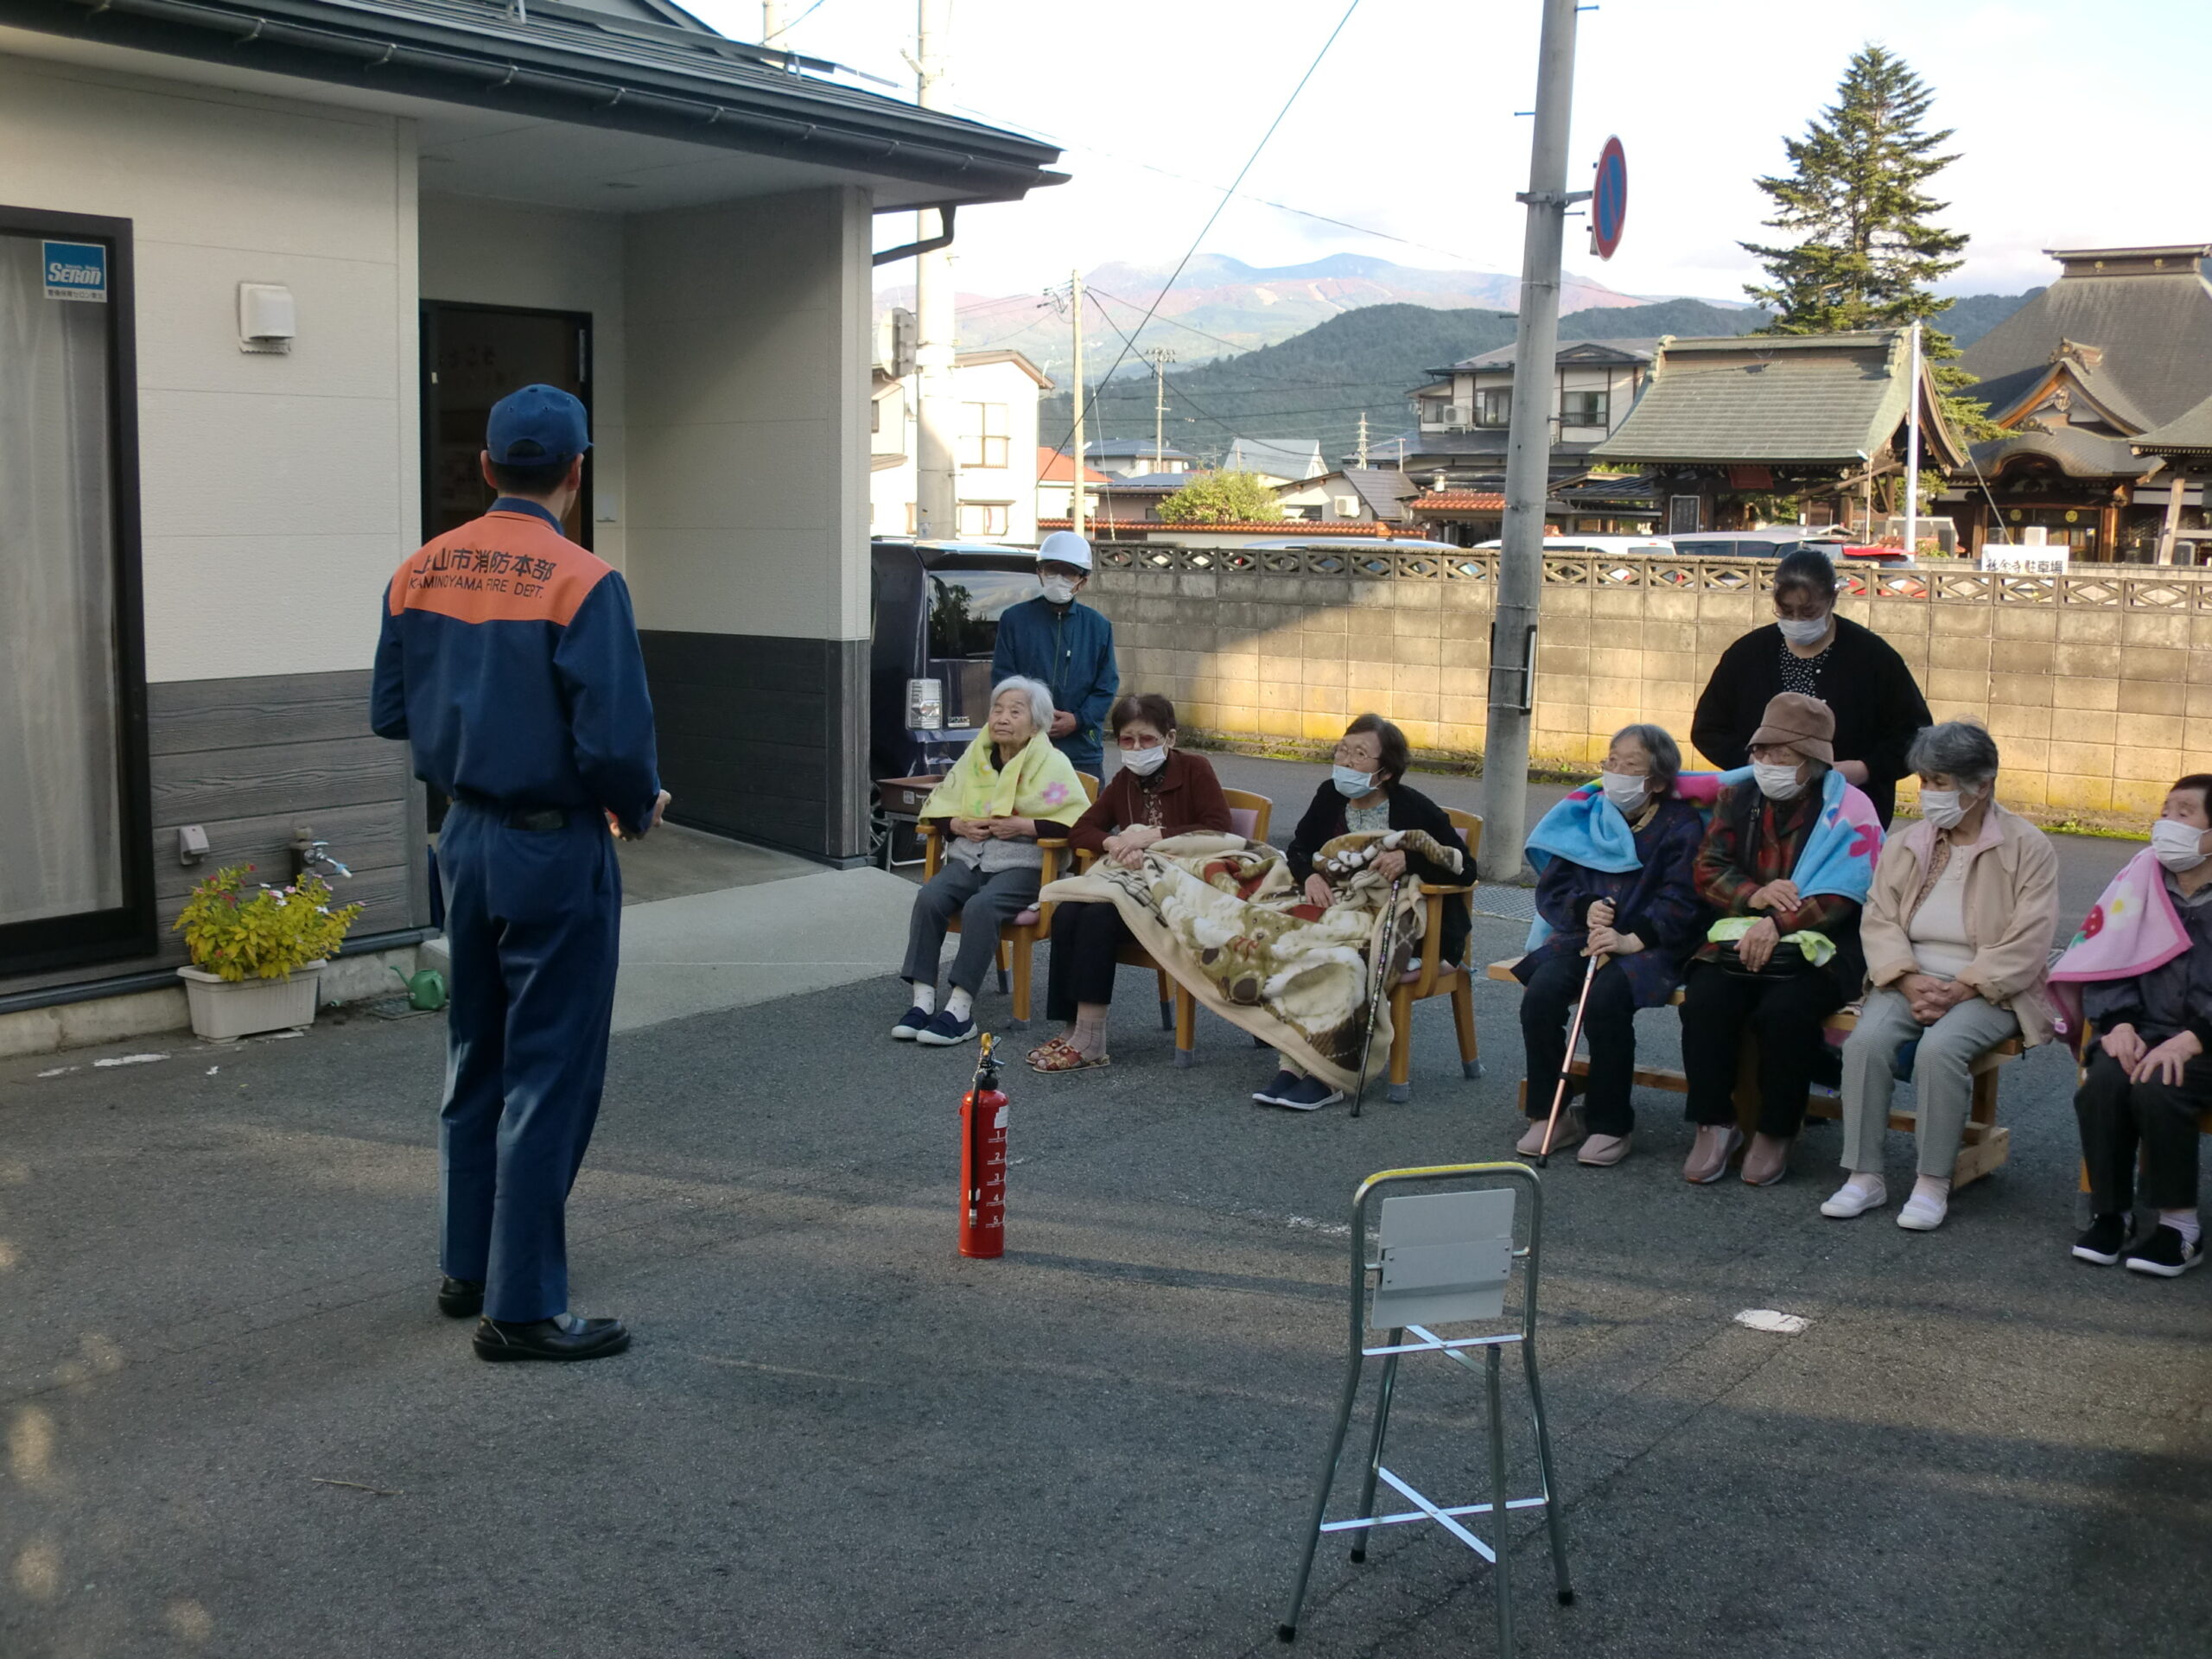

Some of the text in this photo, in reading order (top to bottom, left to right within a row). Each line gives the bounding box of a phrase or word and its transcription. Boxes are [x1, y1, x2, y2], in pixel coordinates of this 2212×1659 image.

[413, 547, 557, 582] 上山市消防本部
[514, 582, 543, 599] DEPT.
[996, 1130, 1001, 1140] 1
[995, 1152, 1001, 1160] 2
[995, 1173, 1000, 1182] 3
[993, 1193, 1000, 1202] 4
[993, 1216, 999, 1224] 5
